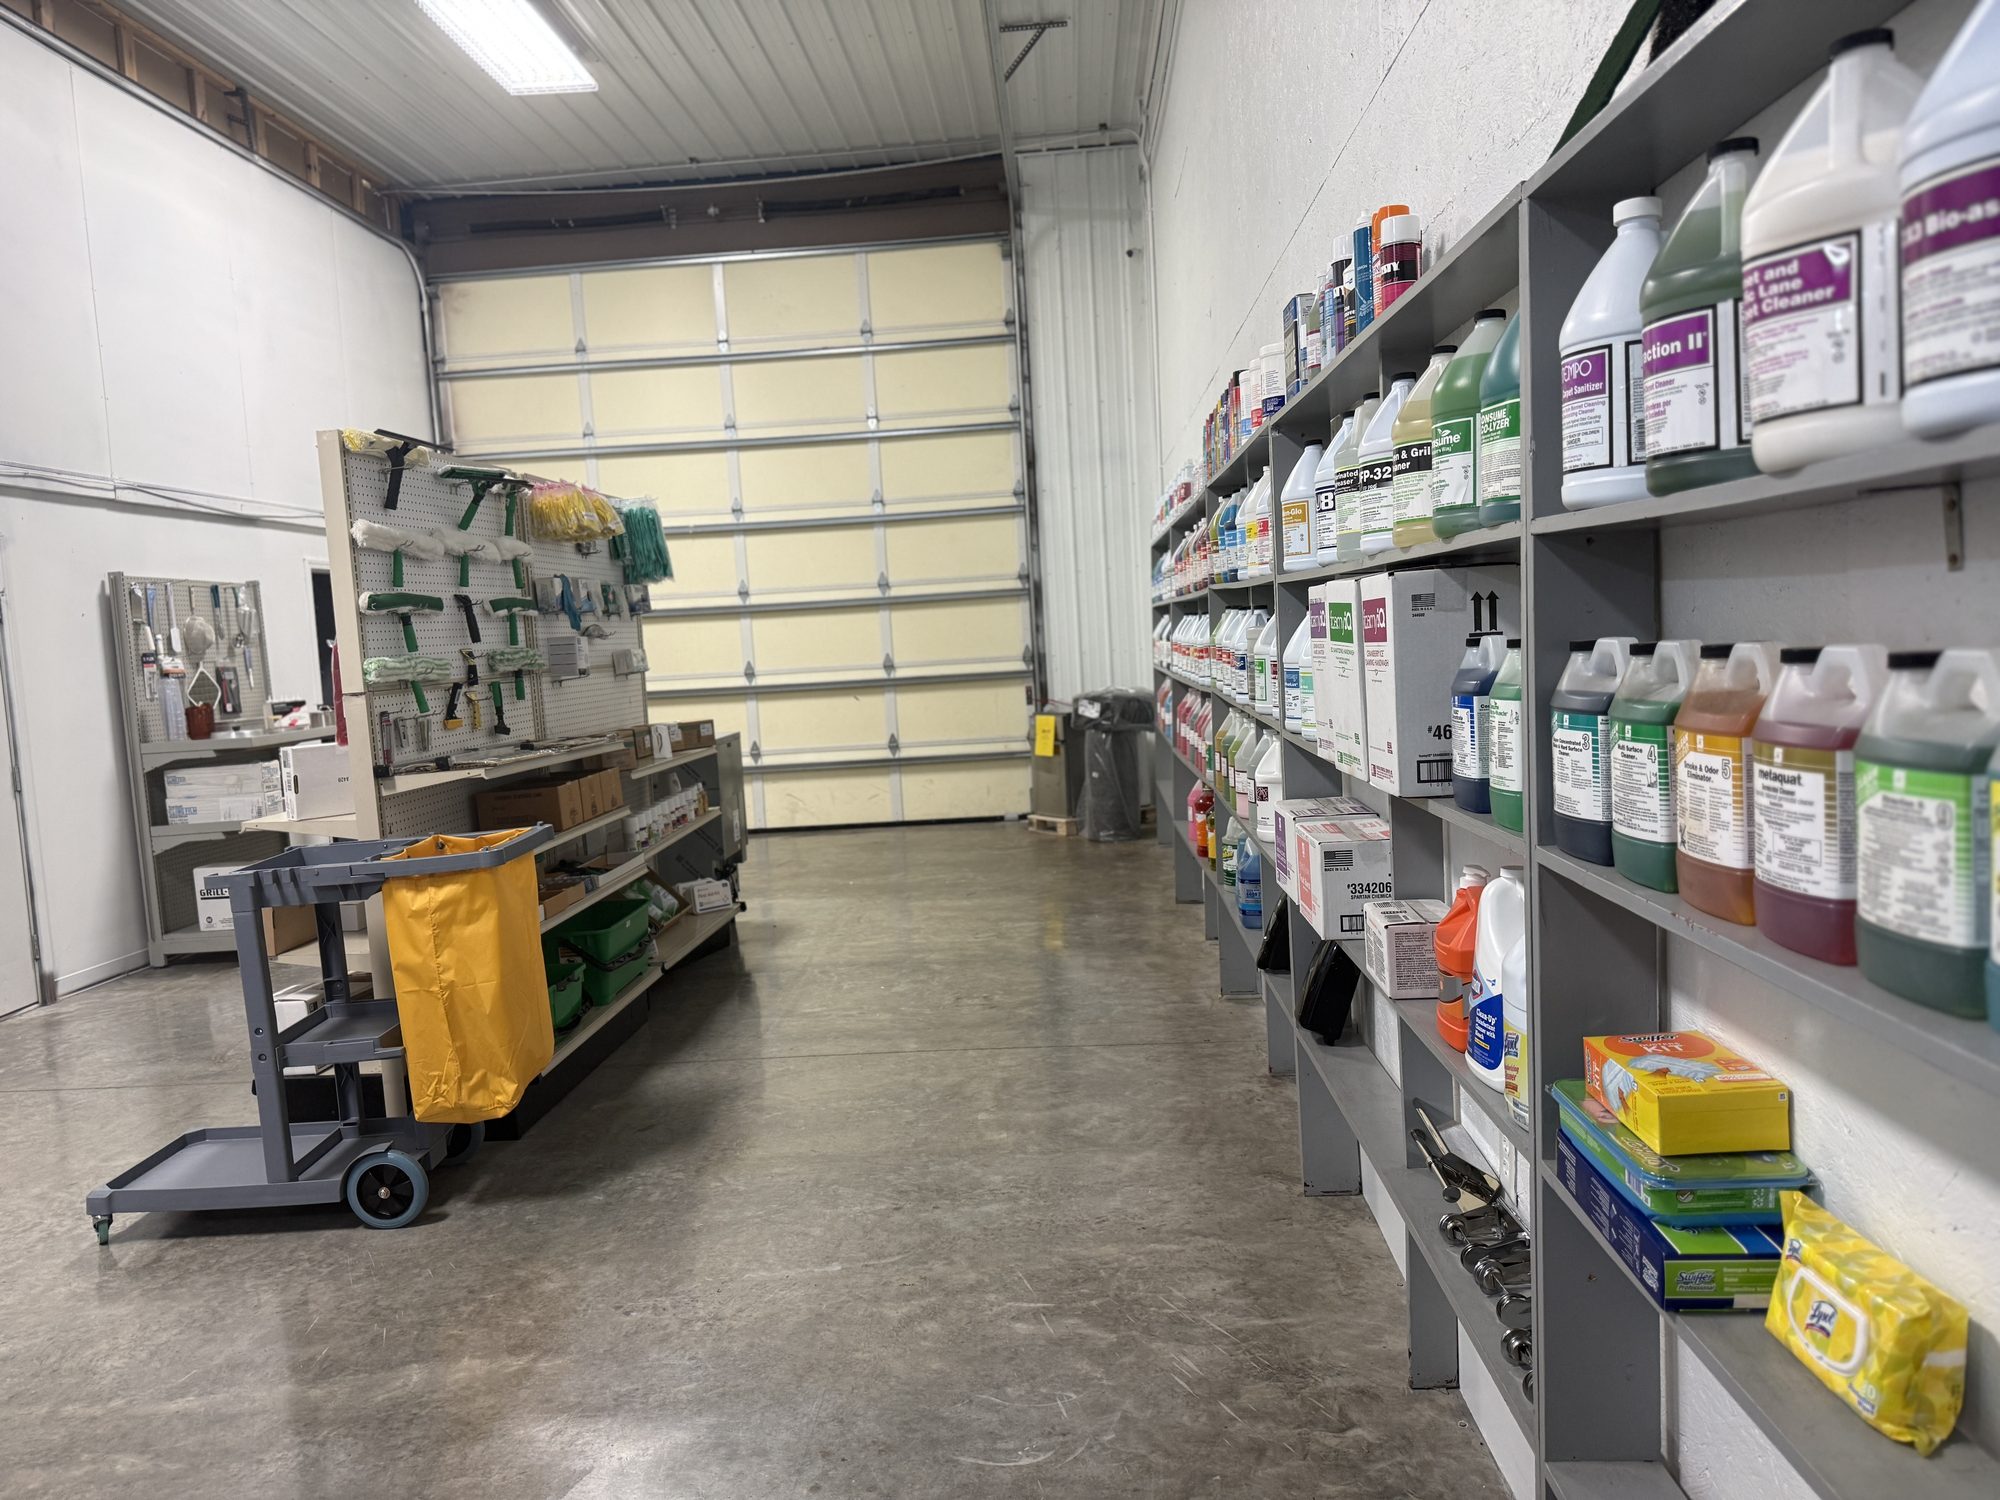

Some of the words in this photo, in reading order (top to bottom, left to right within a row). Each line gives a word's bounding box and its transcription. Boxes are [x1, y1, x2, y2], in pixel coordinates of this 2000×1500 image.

[1764, 259, 1799, 281] and
[1758, 278, 1803, 298] Lane
[1761, 285, 1835, 312] Cleaner
[1574, 382, 1603, 395] Sanitizer
[1584, 400, 1606, 409] Cleaning
[1401, 450, 1408, 459] &
[1582, 733, 1591, 751] 3
[1626, 745, 1643, 754] Surface
[1647, 745, 1657, 764] 4
[1698, 764, 1704, 773] &
[1704, 765, 1719, 775] Odor
[1721, 758, 1731, 780] 5
[1687, 770, 1712, 783] Eliminator
[1758, 768, 1802, 786] metaquat
[1347, 882, 1392, 895] #334206
[1476, 1008, 1495, 1025] Clean-Up
[1486, 1029, 1496, 1039] with
[1618, 1033, 1679, 1045] Swiffer
[1643, 1044, 1684, 1053] KIT
[1592, 1065, 1601, 1090] KIT
[1676, 1271, 1714, 1285] Swiffer
[1677, 1284, 1716, 1292] Professional
[1809, 1303, 1837, 1326] Lysol
